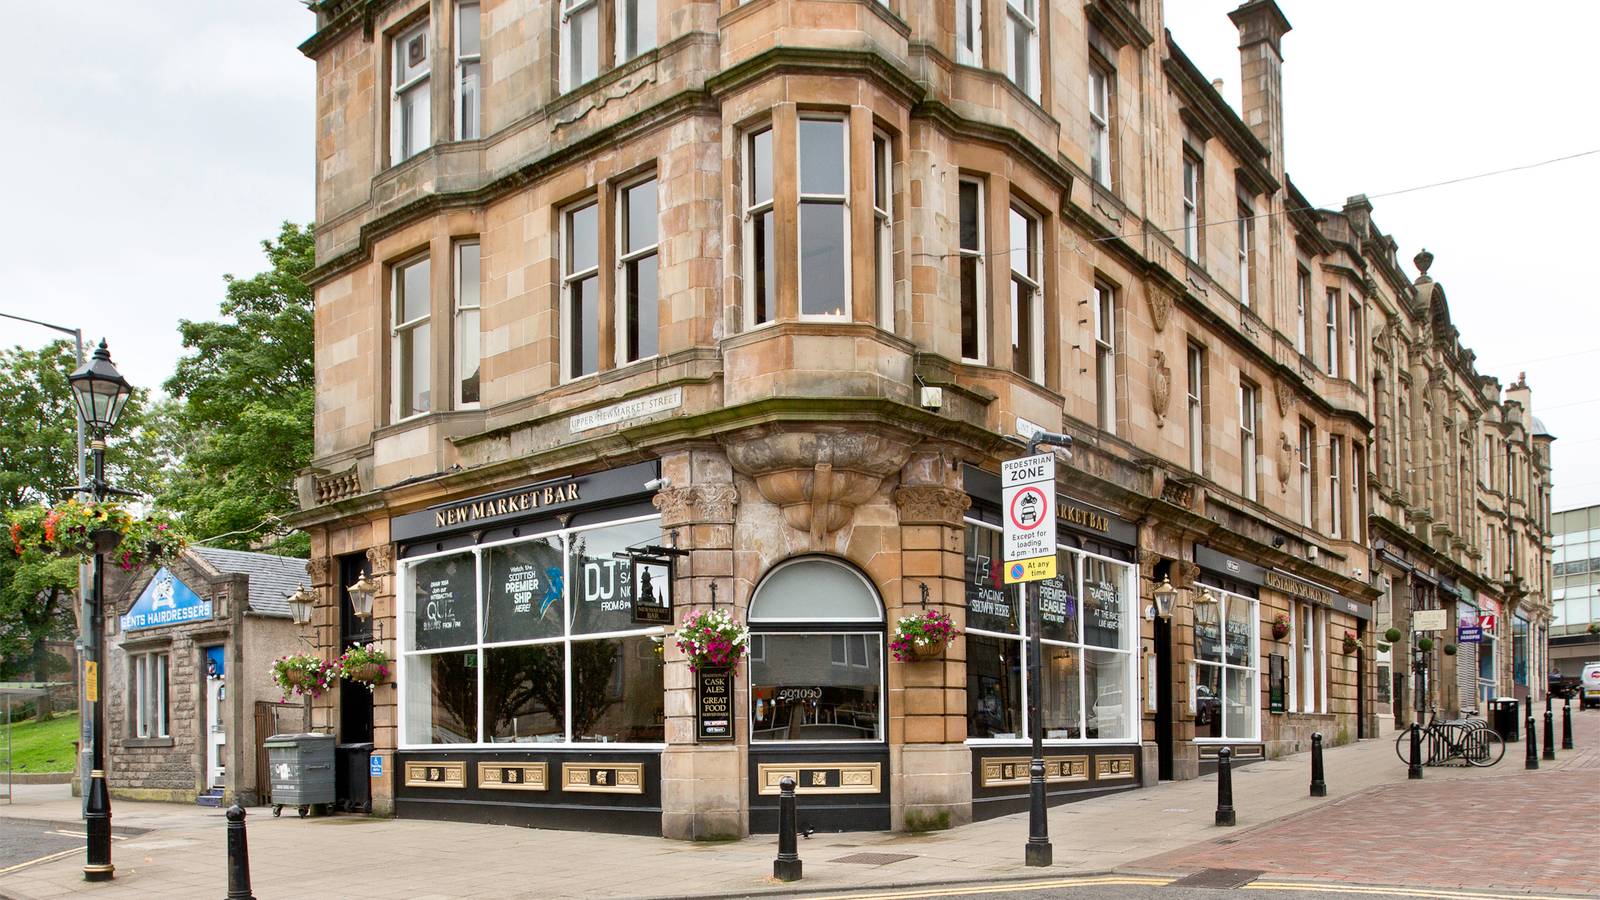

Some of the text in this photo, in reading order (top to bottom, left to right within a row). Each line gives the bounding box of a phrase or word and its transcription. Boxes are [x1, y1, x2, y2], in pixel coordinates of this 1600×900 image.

[571, 393, 678, 428] UPPER NEWMARKET STREET
[1004, 455, 1052, 471] PEDESTRIAN
[1011, 465, 1045, 481] ZONE
[544, 483, 580, 505] BAR
[1055, 502, 1109, 532] ARKET BAR
[1012, 530, 1047, 542] Except for
[1017, 540, 1042, 550] loading
[1027, 560, 1050, 569] At any
[508, 570, 536, 582] SCOTTISH
[1031, 569, 1046, 577] time
[505, 578, 539, 594] PREMIER
[585, 561, 616, 602] DJ
[1040, 578, 1064, 589] ENGLISH
[513, 591, 532, 604] SHIP
[978, 587, 1005, 602] RACING
[1039, 585, 1067, 602] PREMIER
[1089, 586, 1115, 603] RACING
[601, 602, 618, 612] FROM
[971, 599, 994, 615] SHOWN
[1039, 598, 1067, 615] LEAGUE
[120, 602, 211, 628] GENTS HAIRDRESSERS
[704, 678, 725, 686] CASK
[705, 686, 725, 694] ALES
[702, 696, 728, 704] GREAT
[704, 704, 727, 712] FOOD
